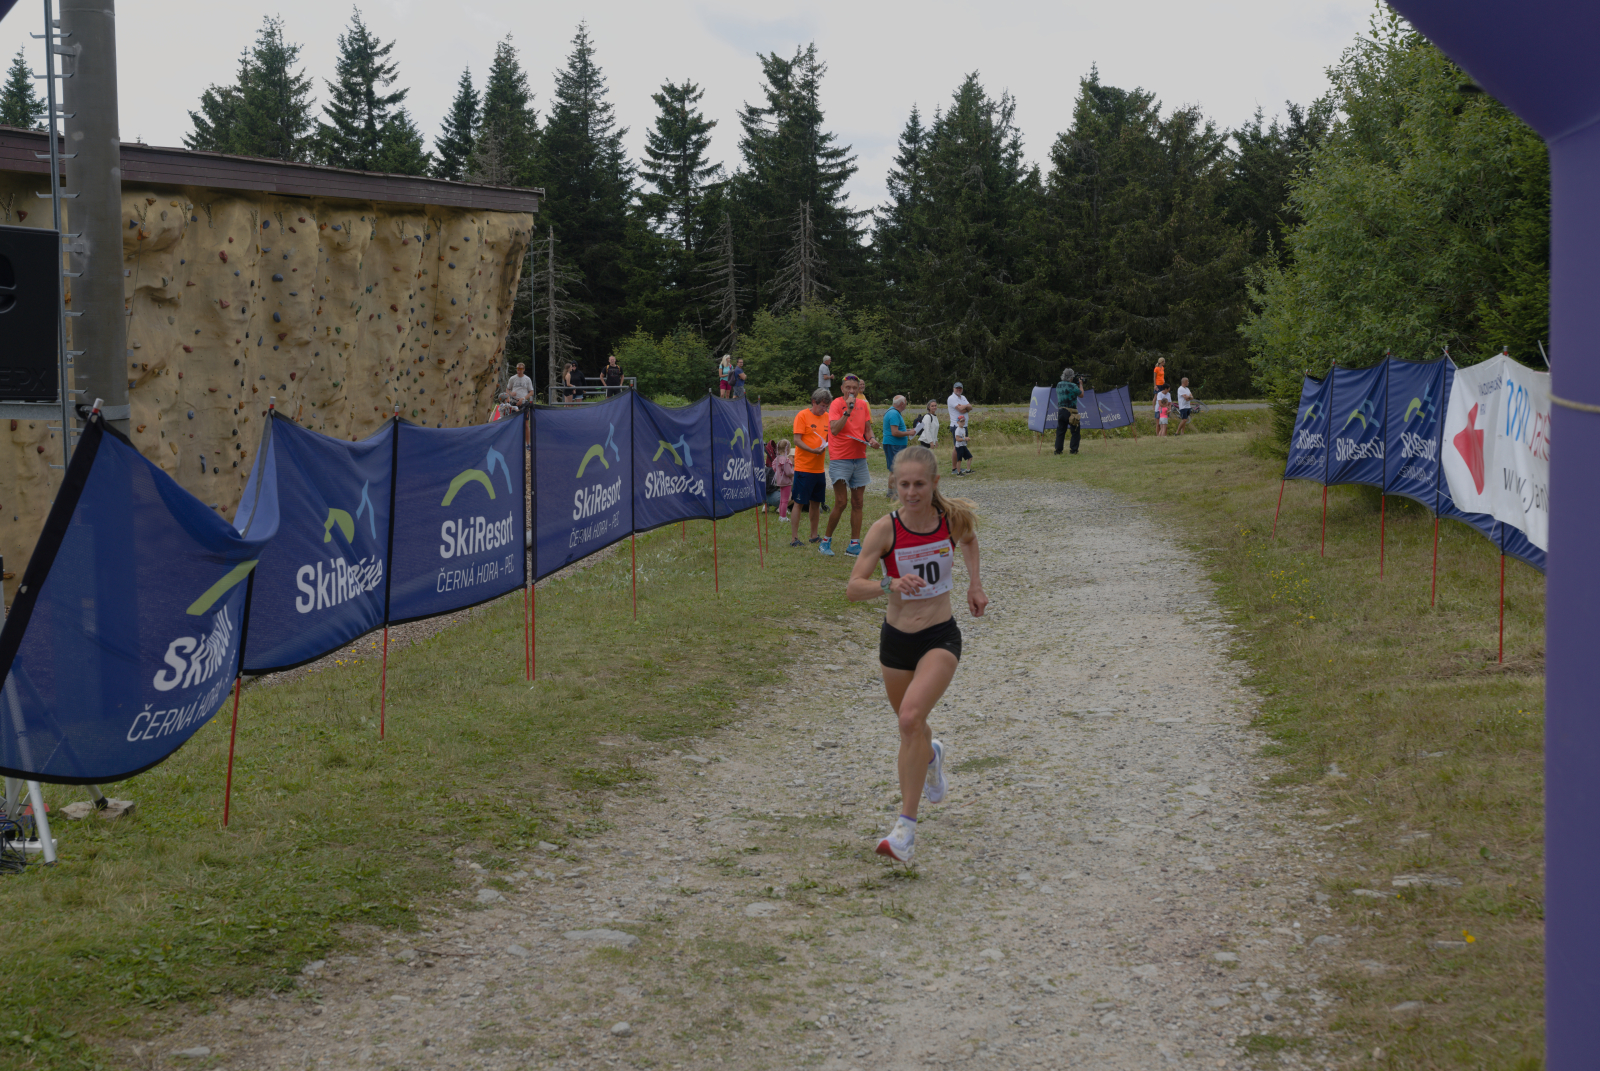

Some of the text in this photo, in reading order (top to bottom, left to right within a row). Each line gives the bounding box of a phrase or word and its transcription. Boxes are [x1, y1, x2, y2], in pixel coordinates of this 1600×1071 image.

[573, 475, 621, 521] SkiResort
[440, 510, 514, 559] SkiResort
[437, 561, 475, 593] ČERNÁ
[476, 560, 499, 585] HORA
[504, 553, 515, 576] PEC
[913, 561, 940, 585] 70
[127, 692, 203, 742] ČERNÁ
